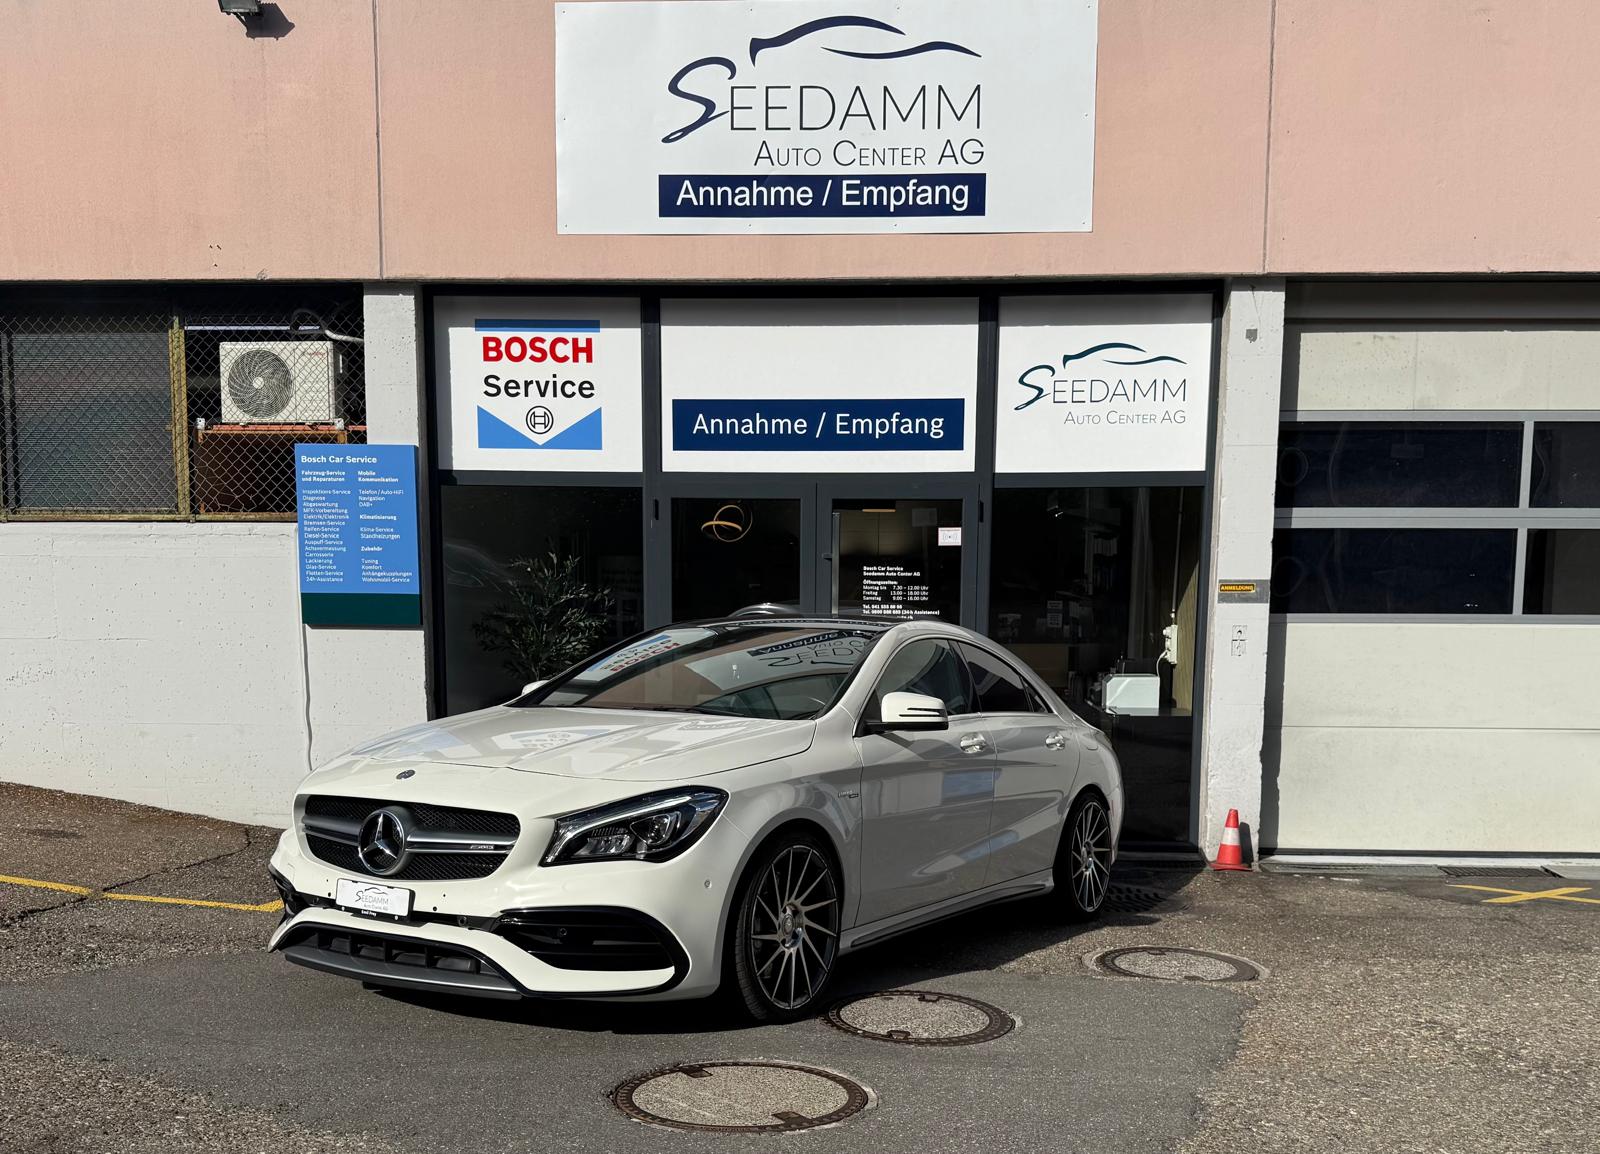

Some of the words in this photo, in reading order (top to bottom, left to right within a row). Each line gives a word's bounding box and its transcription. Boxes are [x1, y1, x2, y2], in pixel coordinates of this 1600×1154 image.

[661, 57, 982, 143] SEEDAMM
[754, 140, 821, 167] AUTO
[833, 140, 926, 167] CENTER
[937, 139, 985, 165] AG
[676, 180, 813, 206] Annahme
[822, 180, 832, 206] /
[842, 179, 969, 212] Empfang
[482, 337, 593, 364] BOSCH
[483, 373, 595, 399] Service
[1014, 364, 1187, 410] SEEDAMM
[693, 413, 808, 435] Annahme
[816, 412, 826, 438] /
[835, 412, 945, 438] Empfang
[1063, 411, 1101, 425] AUTO
[1106, 411, 1157, 425] CENTER
[1160, 410, 1186, 424] AG
